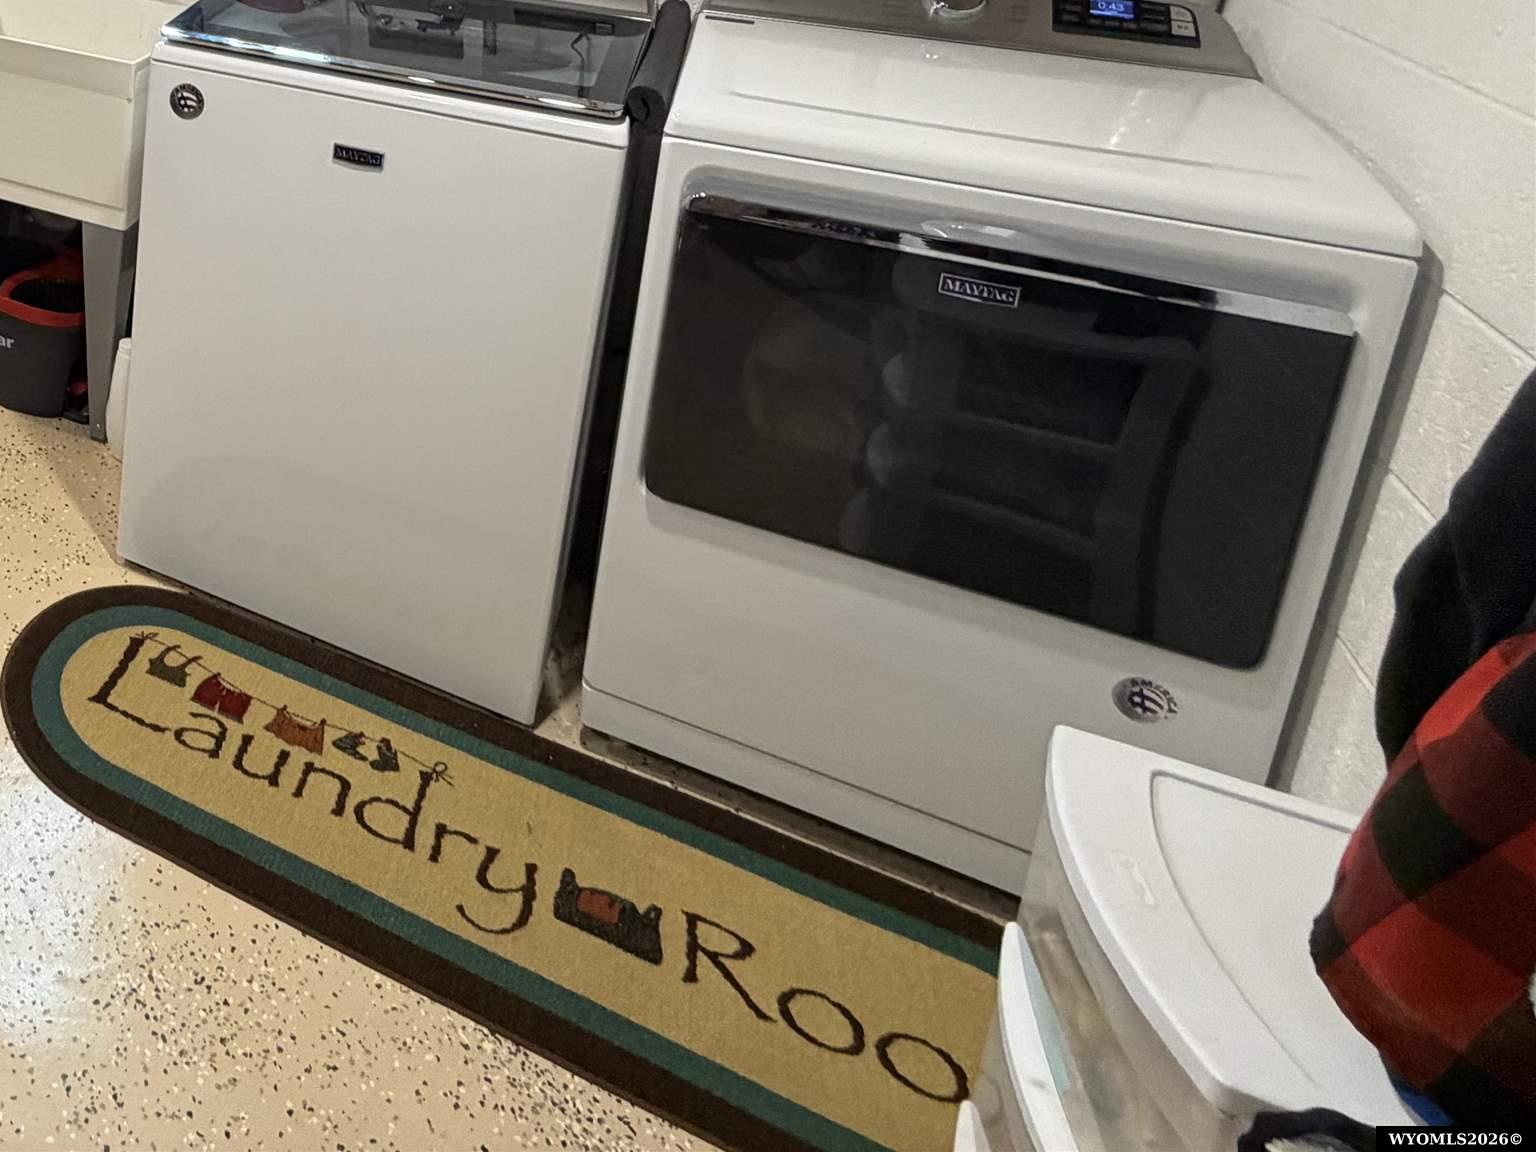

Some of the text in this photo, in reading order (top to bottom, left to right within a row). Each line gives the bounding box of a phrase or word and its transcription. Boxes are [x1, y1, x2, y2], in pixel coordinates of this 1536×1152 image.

[334, 147, 382, 167] MAYTAG
[943, 278, 1016, 305] MAYTAG
[90, 632, 971, 1104] Laundry Roo
